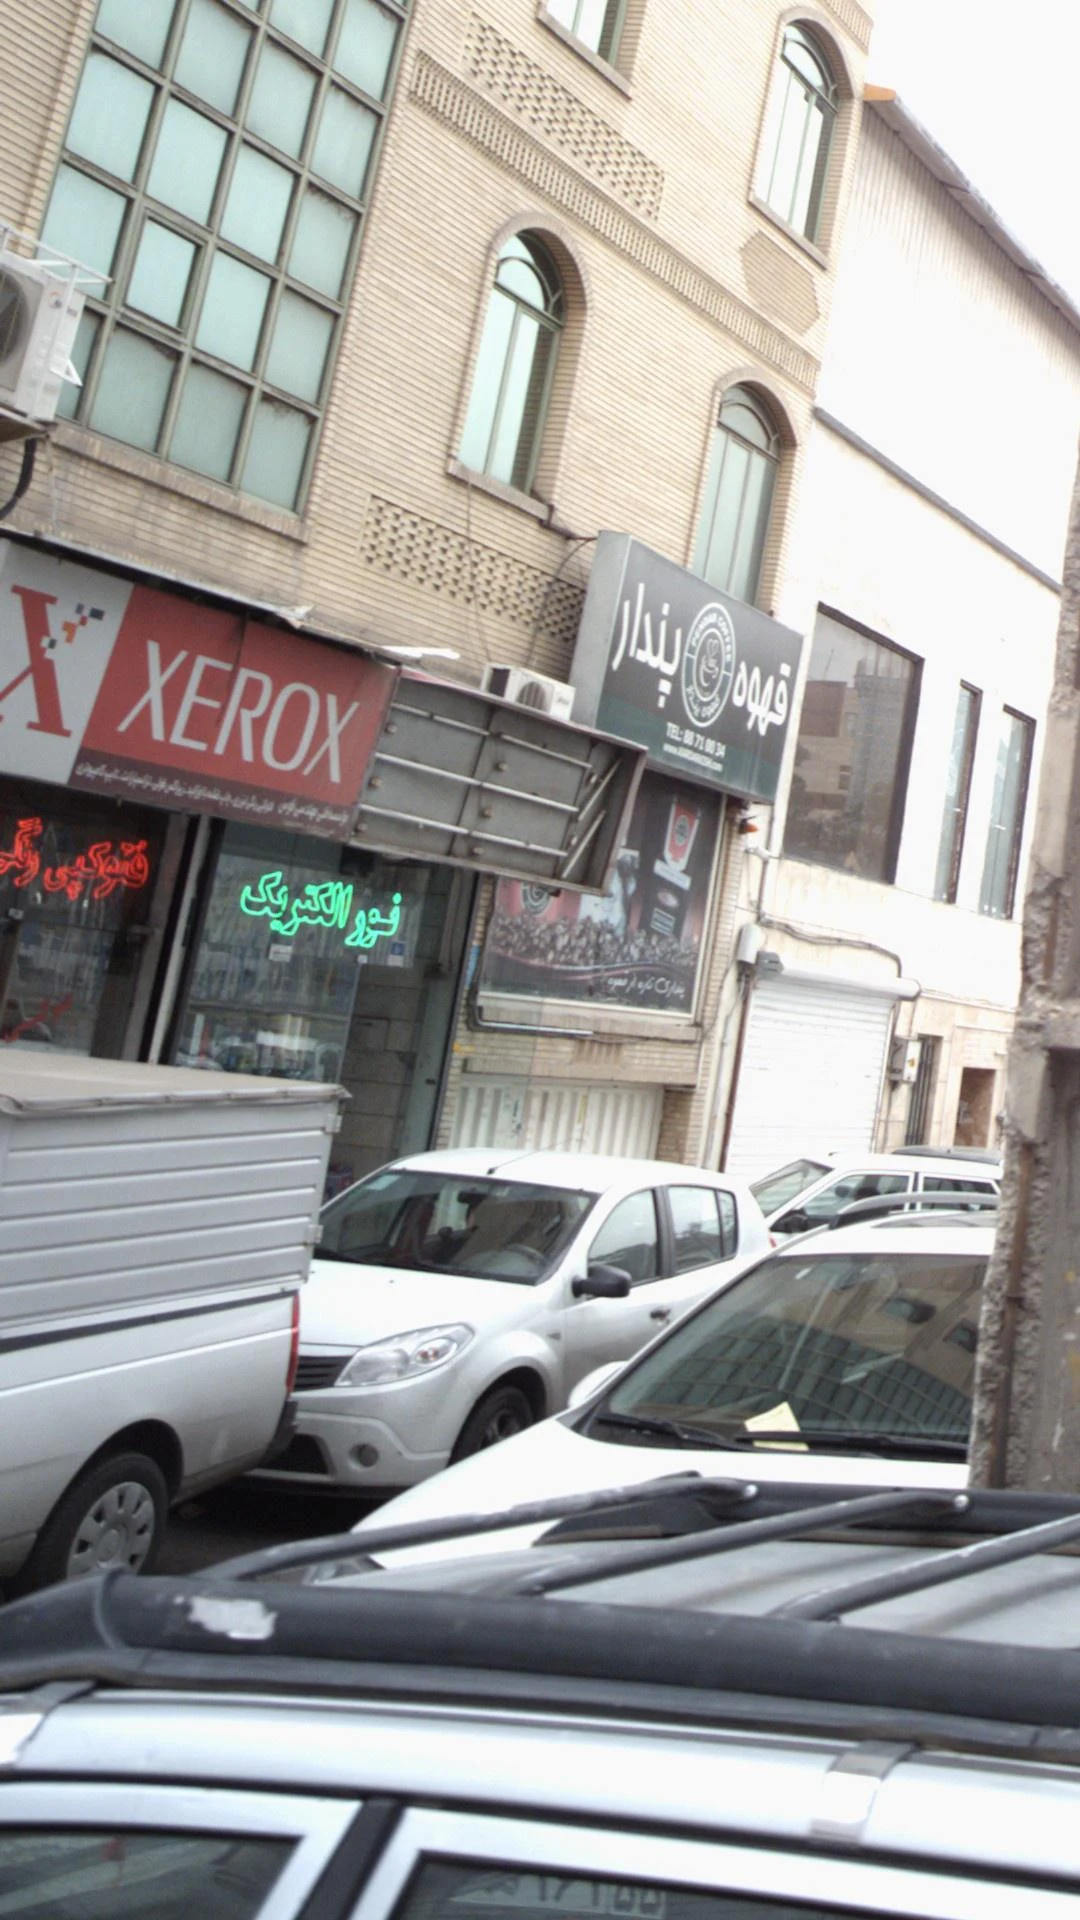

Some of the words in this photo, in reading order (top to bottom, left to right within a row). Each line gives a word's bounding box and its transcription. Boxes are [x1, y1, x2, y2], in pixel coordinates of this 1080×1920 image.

[611, 582, 682, 708] پندار
[117, 640, 360, 784] XEROX
[732, 660, 791, 736] قهوه
[43, 839, 149, 901] فتوکپی
[239, 870, 354, 936] الکتریک
